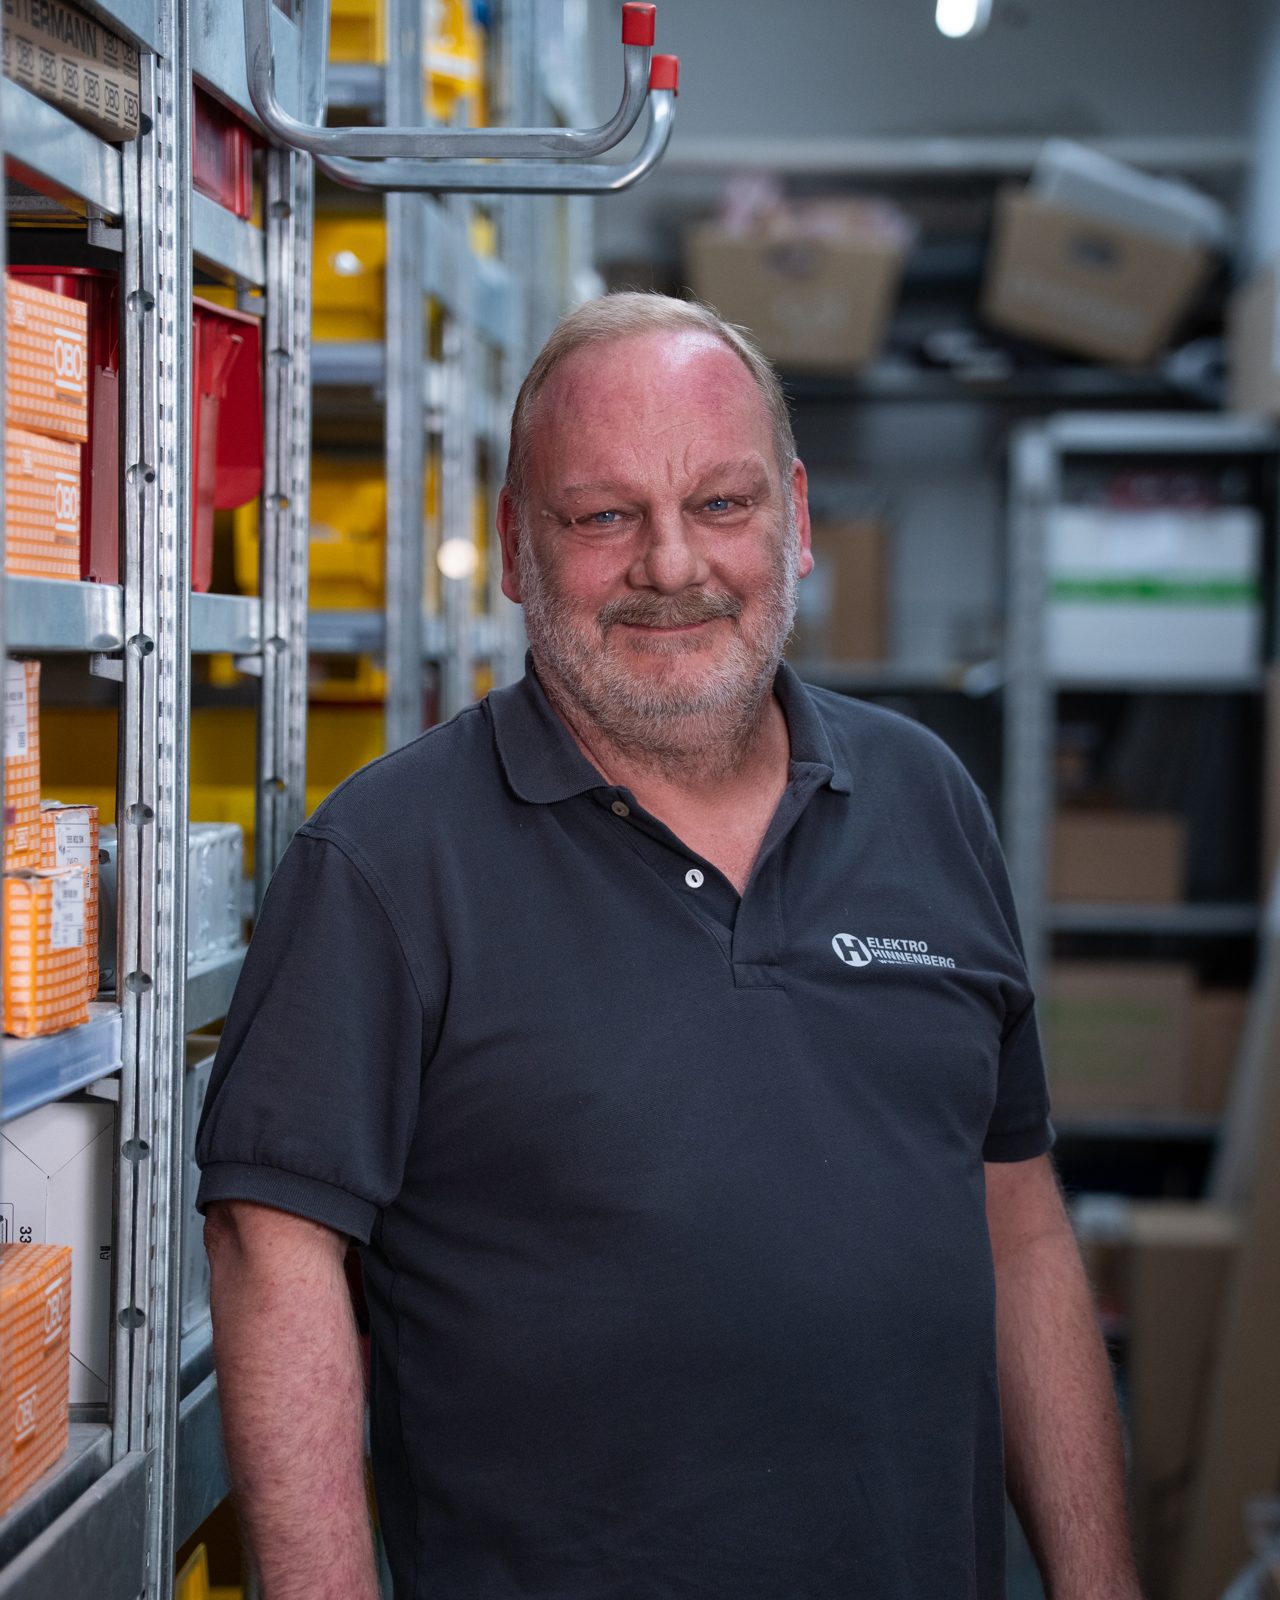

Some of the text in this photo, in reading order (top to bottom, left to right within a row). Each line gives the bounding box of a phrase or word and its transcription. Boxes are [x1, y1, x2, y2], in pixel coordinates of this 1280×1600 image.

[40, 53, 57, 81] OBO
[62, 64, 79, 92] OBO
[83, 75, 100, 102] OBO
[104, 85, 120, 112] OBO
[124, 94, 139, 121] OBO
[54, 338, 83, 382] OBO
[55, 482, 77, 521] OBO
[866, 937, 928, 953] ELEKTRO
[871, 948, 956, 968] HINNENBERG
[19, 1226, 32, 1244] 33
